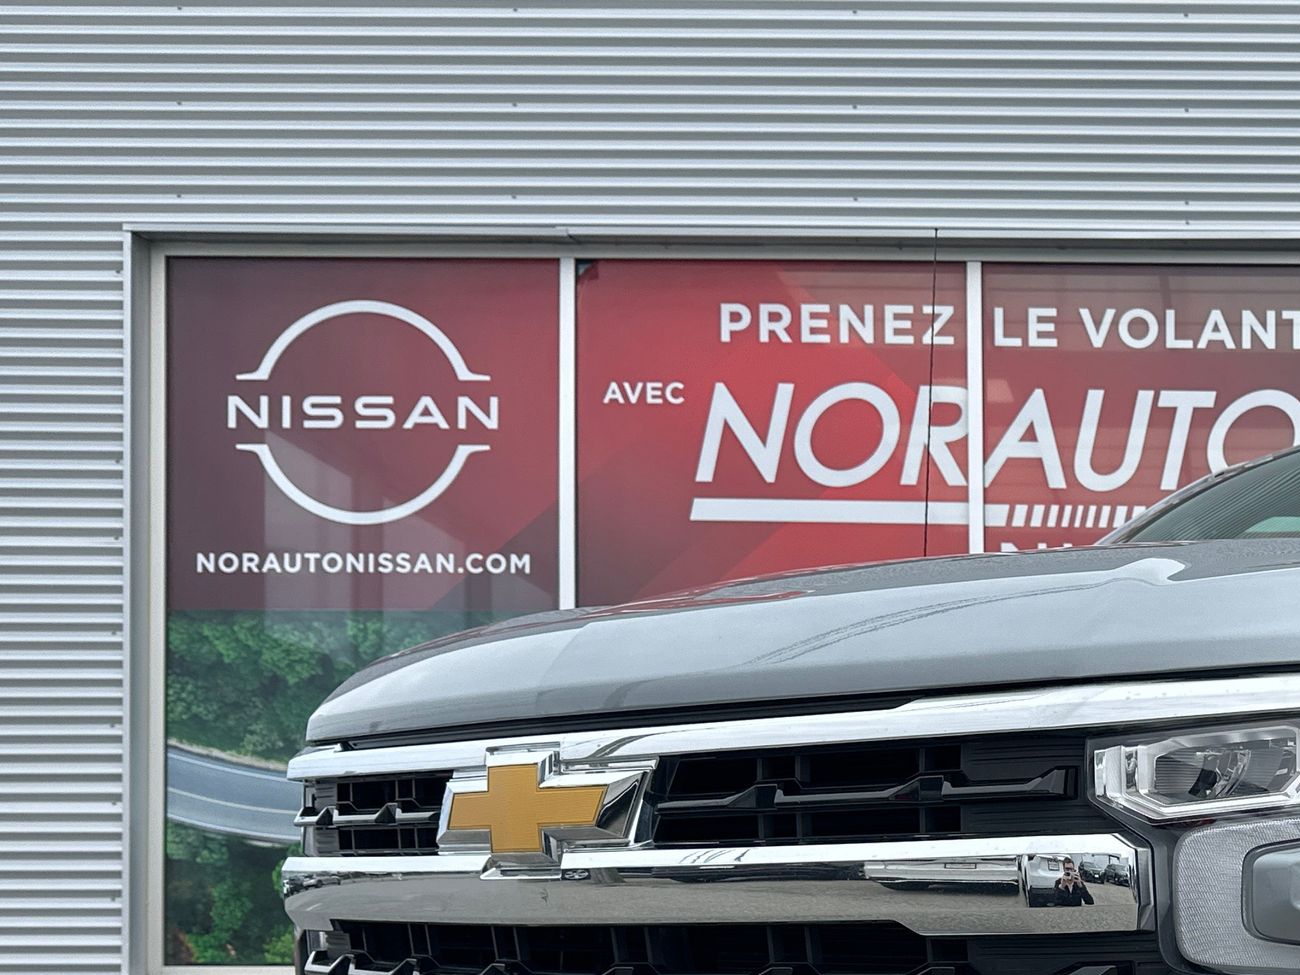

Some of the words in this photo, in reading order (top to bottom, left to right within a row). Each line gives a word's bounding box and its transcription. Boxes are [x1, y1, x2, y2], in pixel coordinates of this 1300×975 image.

[719, 302, 956, 346] PRENEZ
[993, 306, 1059, 349] LE
[602, 380, 686, 405] AVEC
[226, 395, 500, 430] NISSAN
[195, 551, 532, 575] NORAUTONISSAN.COM
